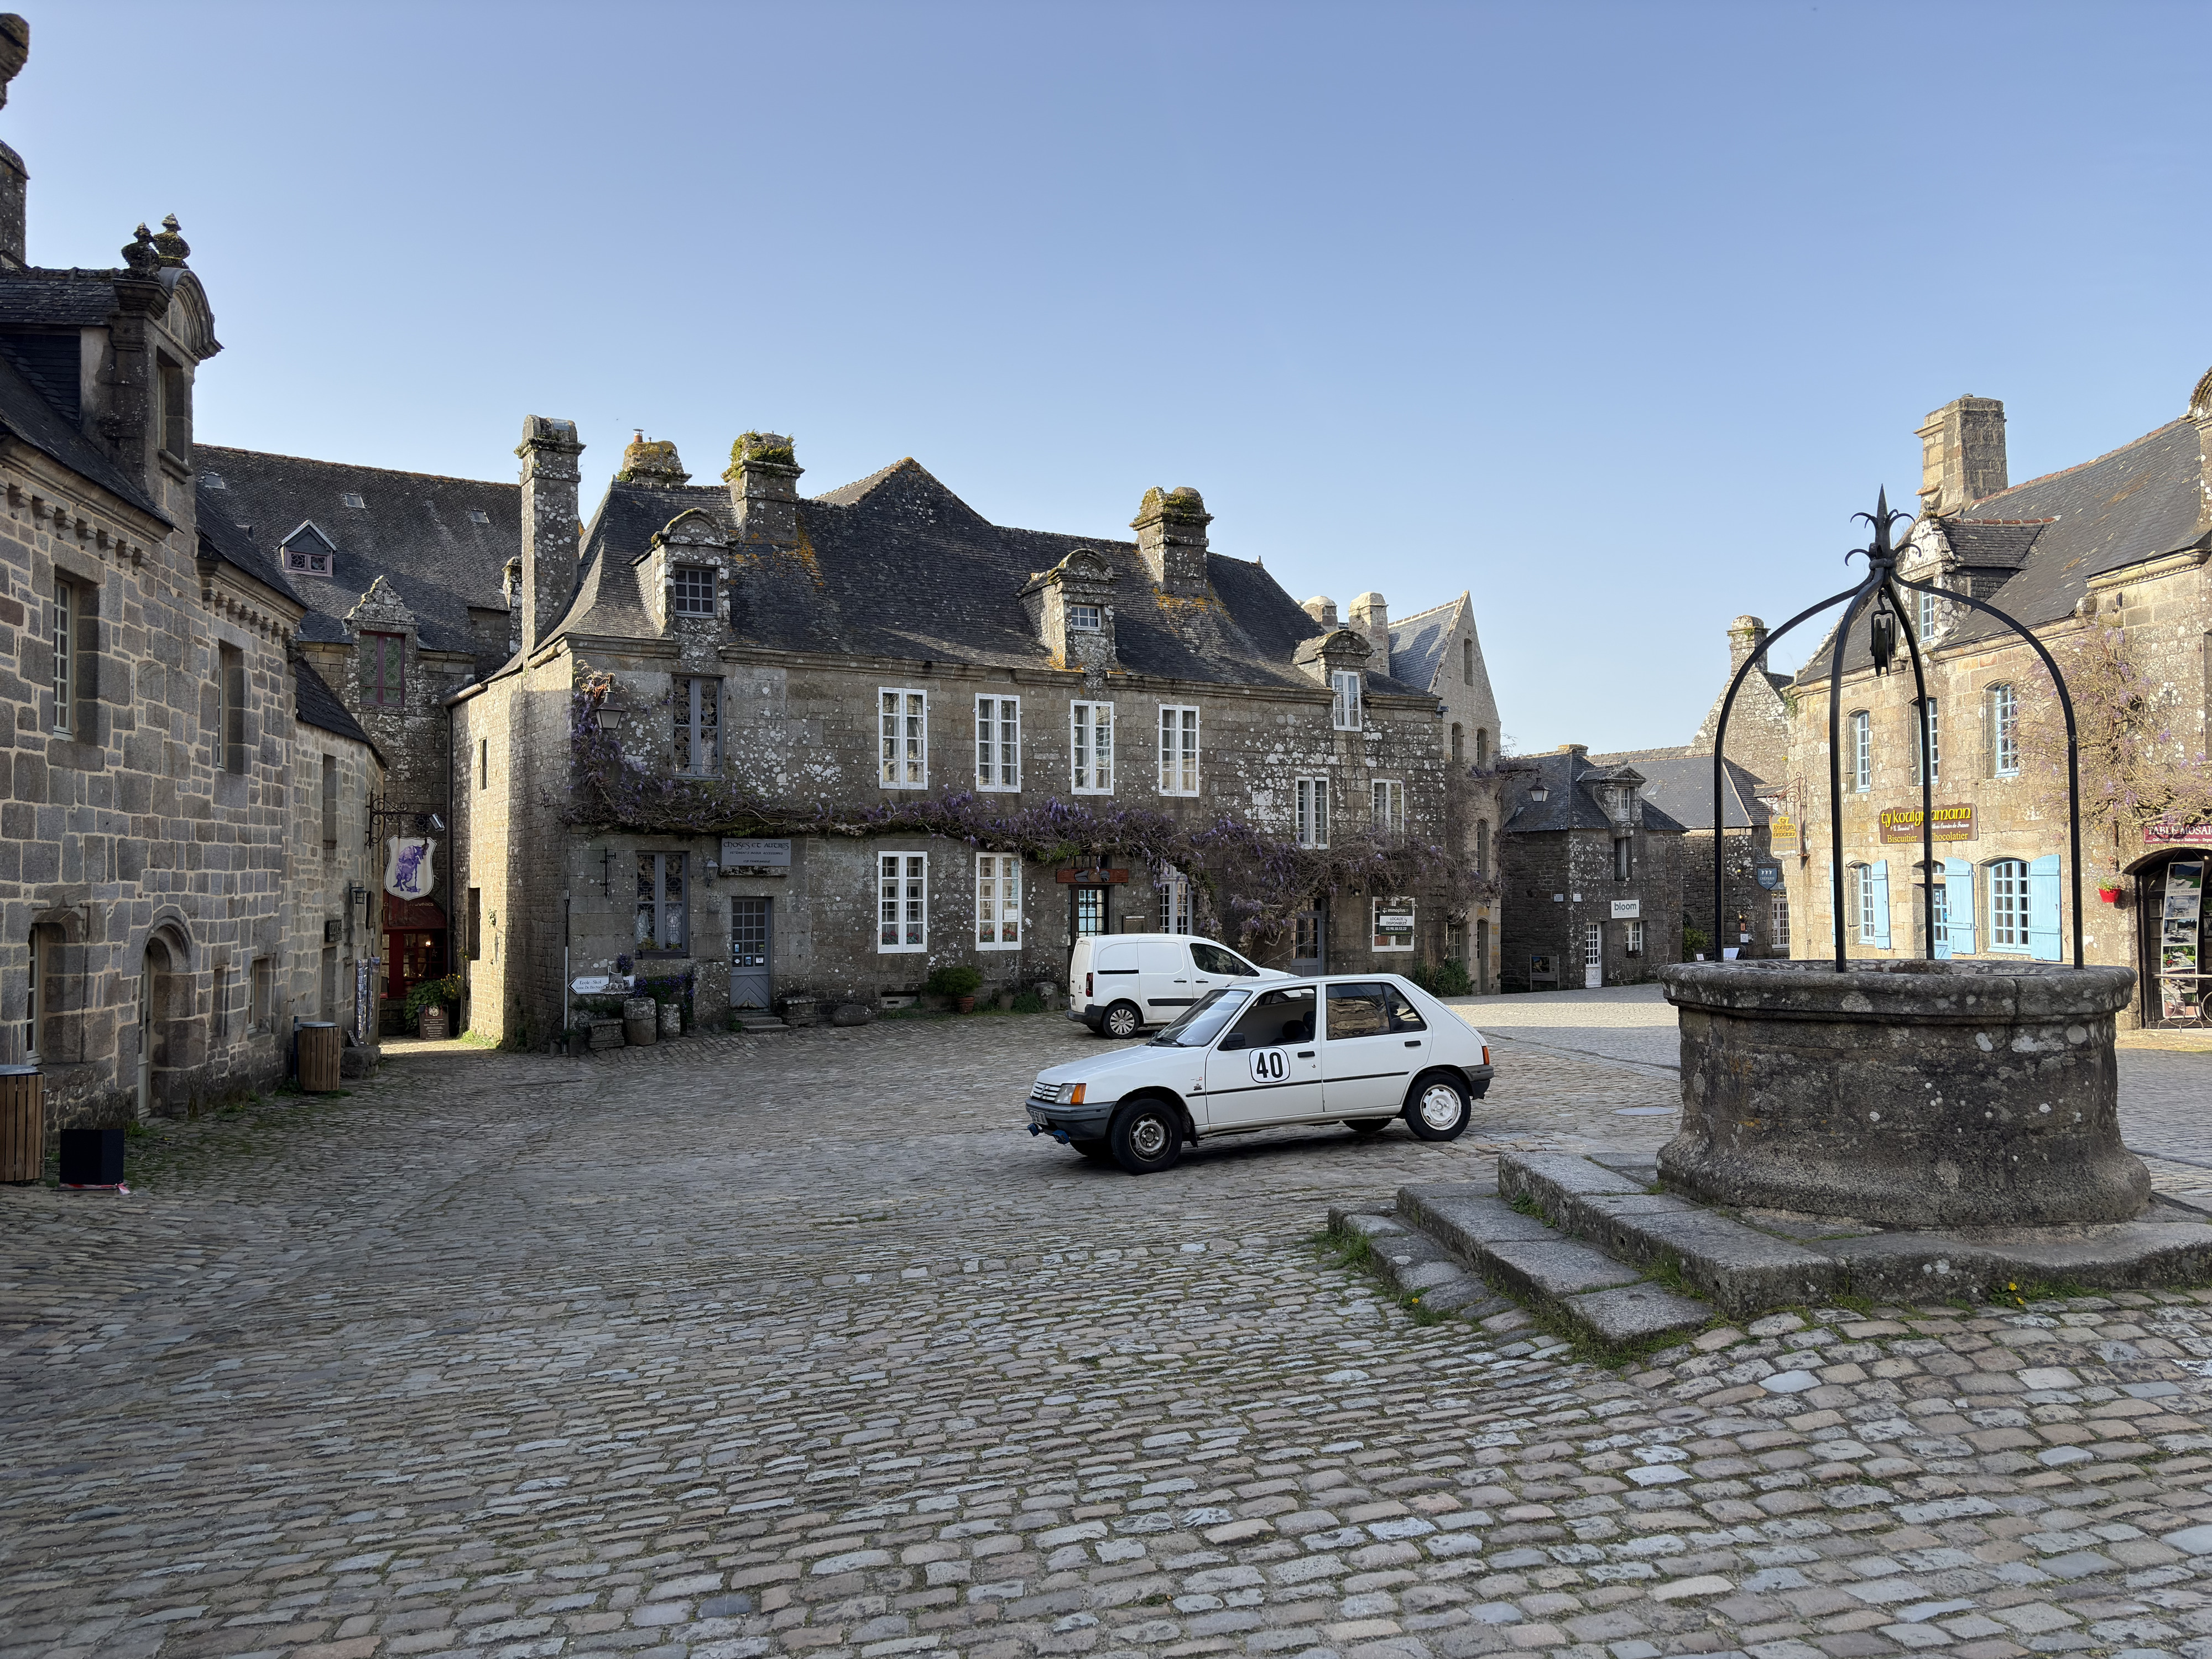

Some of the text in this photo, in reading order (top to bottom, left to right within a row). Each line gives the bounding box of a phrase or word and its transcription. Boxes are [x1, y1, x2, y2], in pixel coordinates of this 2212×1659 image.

[1881, 812, 1891, 827] ty
[2180, 825, 2212, 834] MOSAI
[1887, 833, 1918, 843] Biscuitier
[1614, 902, 1637, 911] bloom
[1256, 1052, 1283, 1078] 40
